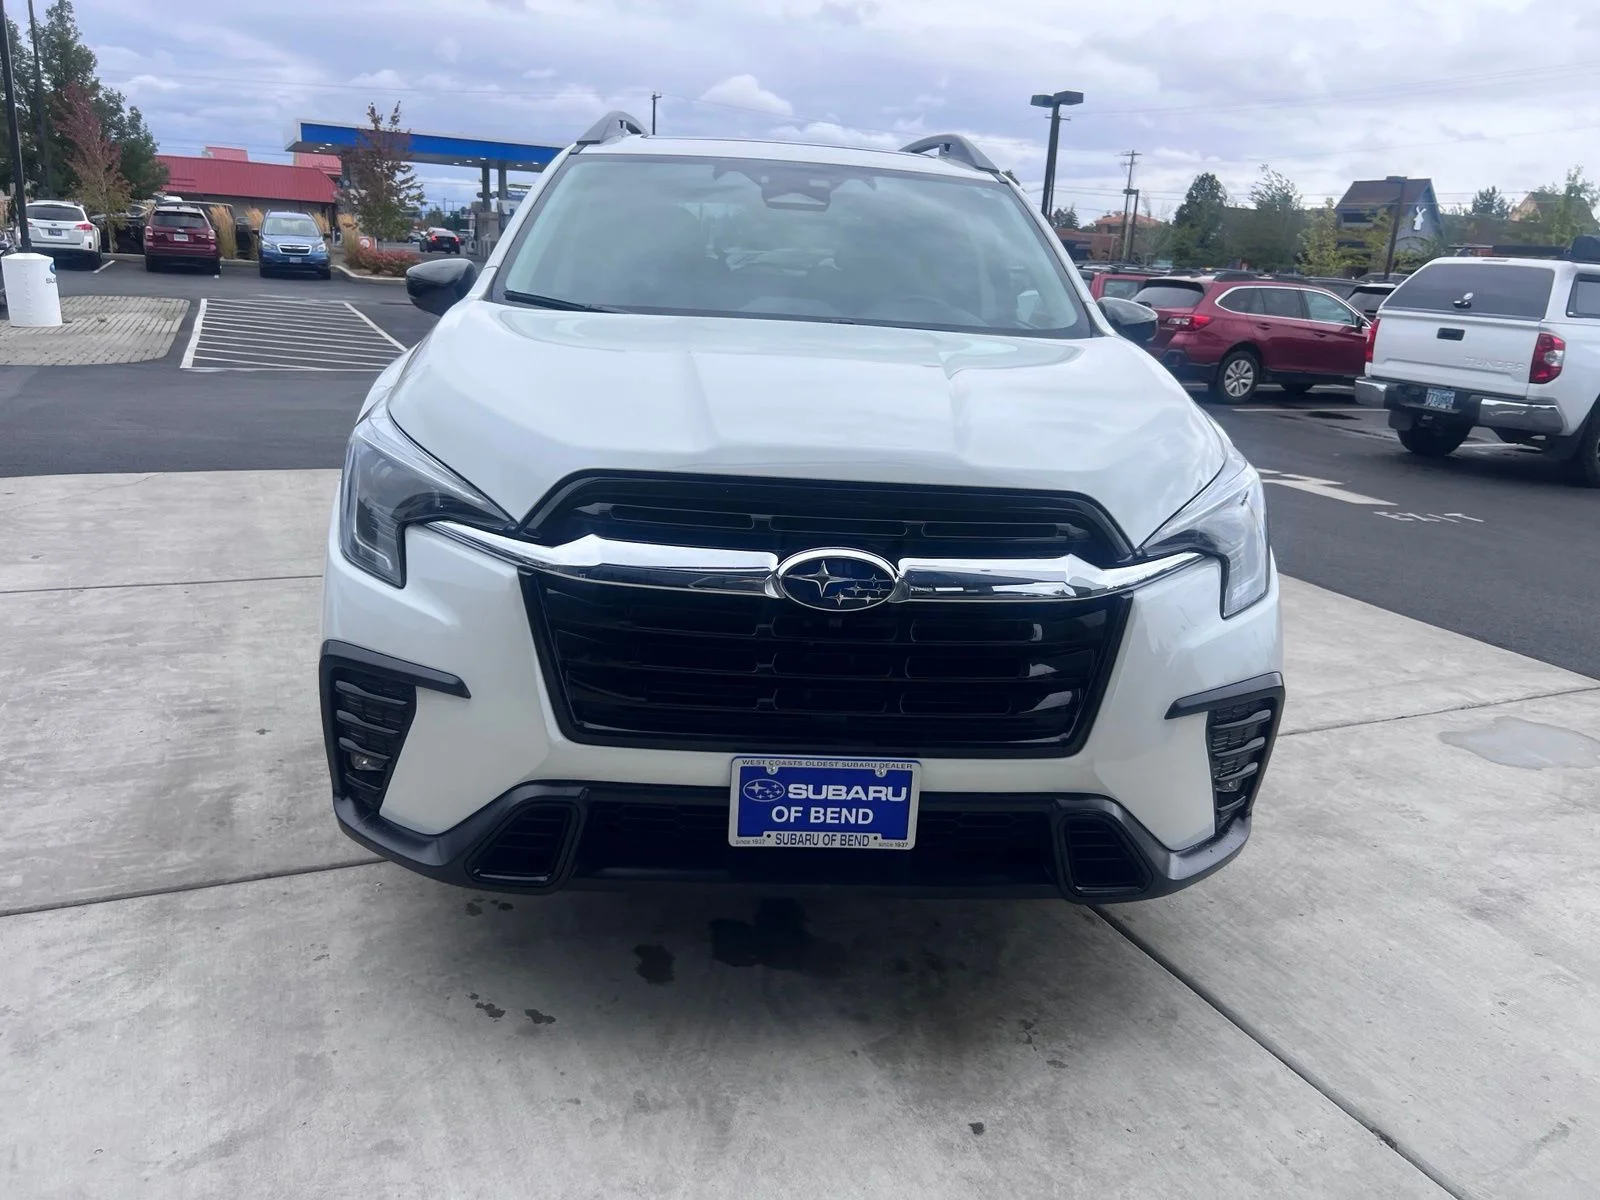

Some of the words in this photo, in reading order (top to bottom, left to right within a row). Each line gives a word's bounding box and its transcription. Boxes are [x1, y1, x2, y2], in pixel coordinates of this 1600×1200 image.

[1373, 511, 1484, 523] EXIT
[768, 759, 803, 767] COASTS
[805, 760, 839, 768] OLDEST
[878, 762, 913, 770] DEALER
[787, 783, 908, 803] SUBARU
[771, 805, 803, 824] OF
[809, 807, 875, 825] BEND
[775, 832, 820, 846] SUBARU
[822, 833, 837, 846] OF
[840, 834, 870, 847] BEND
